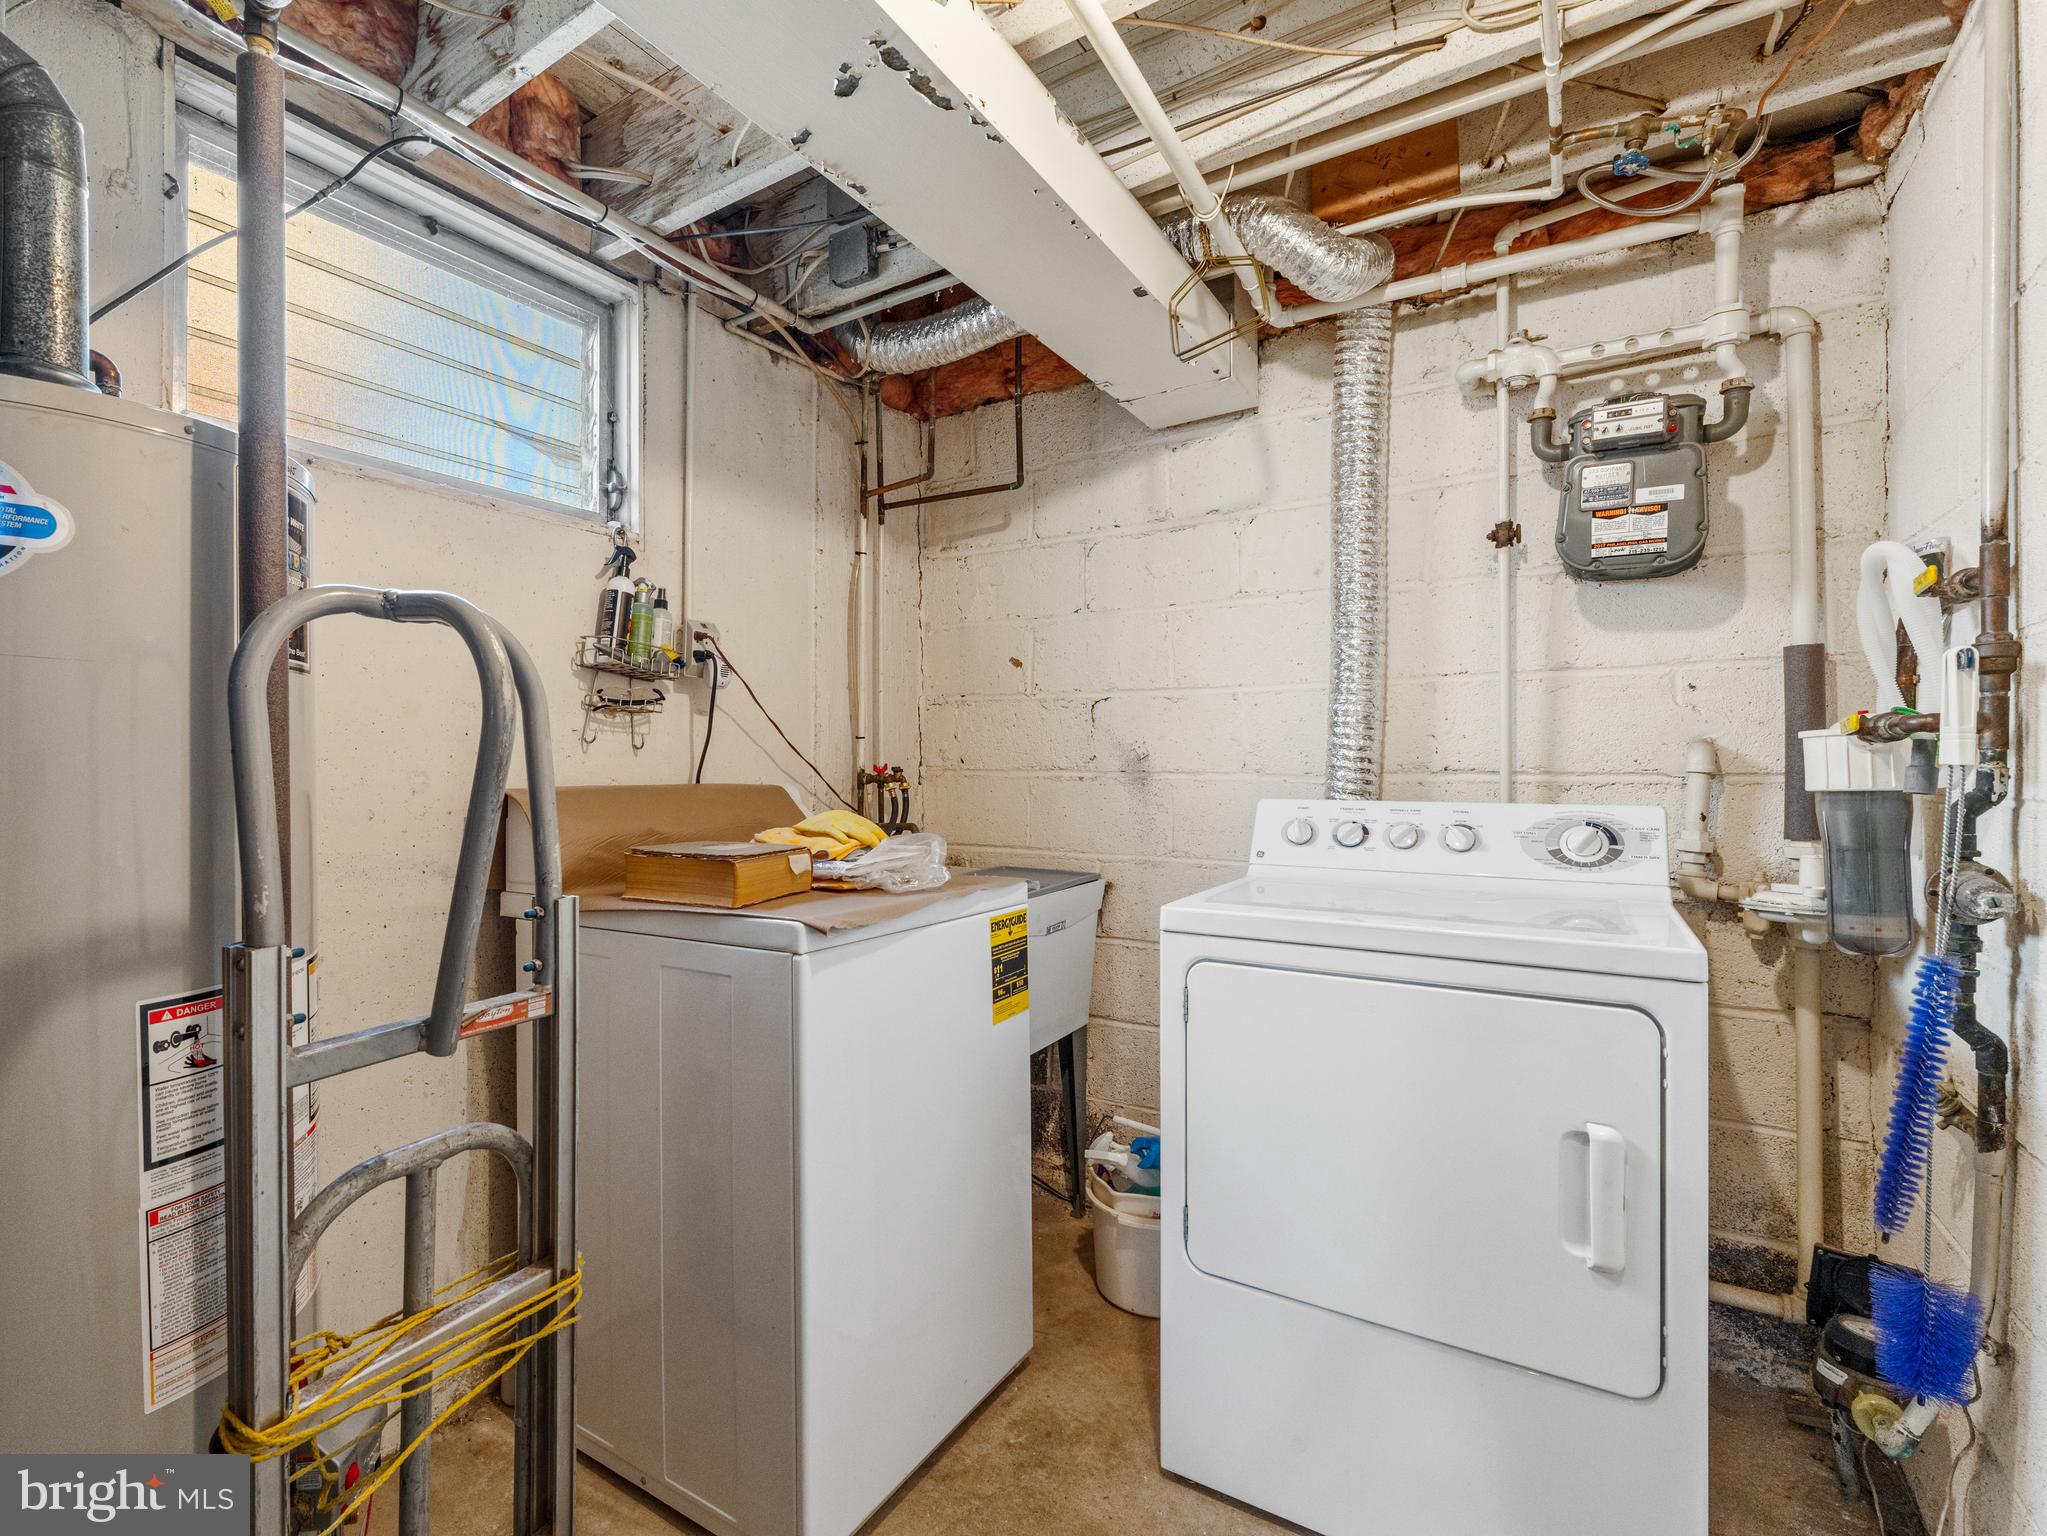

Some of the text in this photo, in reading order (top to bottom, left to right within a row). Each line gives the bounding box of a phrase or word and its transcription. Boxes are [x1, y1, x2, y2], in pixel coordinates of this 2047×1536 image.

[176, 1001, 216, 1016] DANGER
[190, 1042, 204, 1051] HOT
[170, 1190, 220, 1212] FOR YOUR SAFETY
[160, 1212, 176, 1221] READ
[177, 1203, 200, 1215] BEFORE
